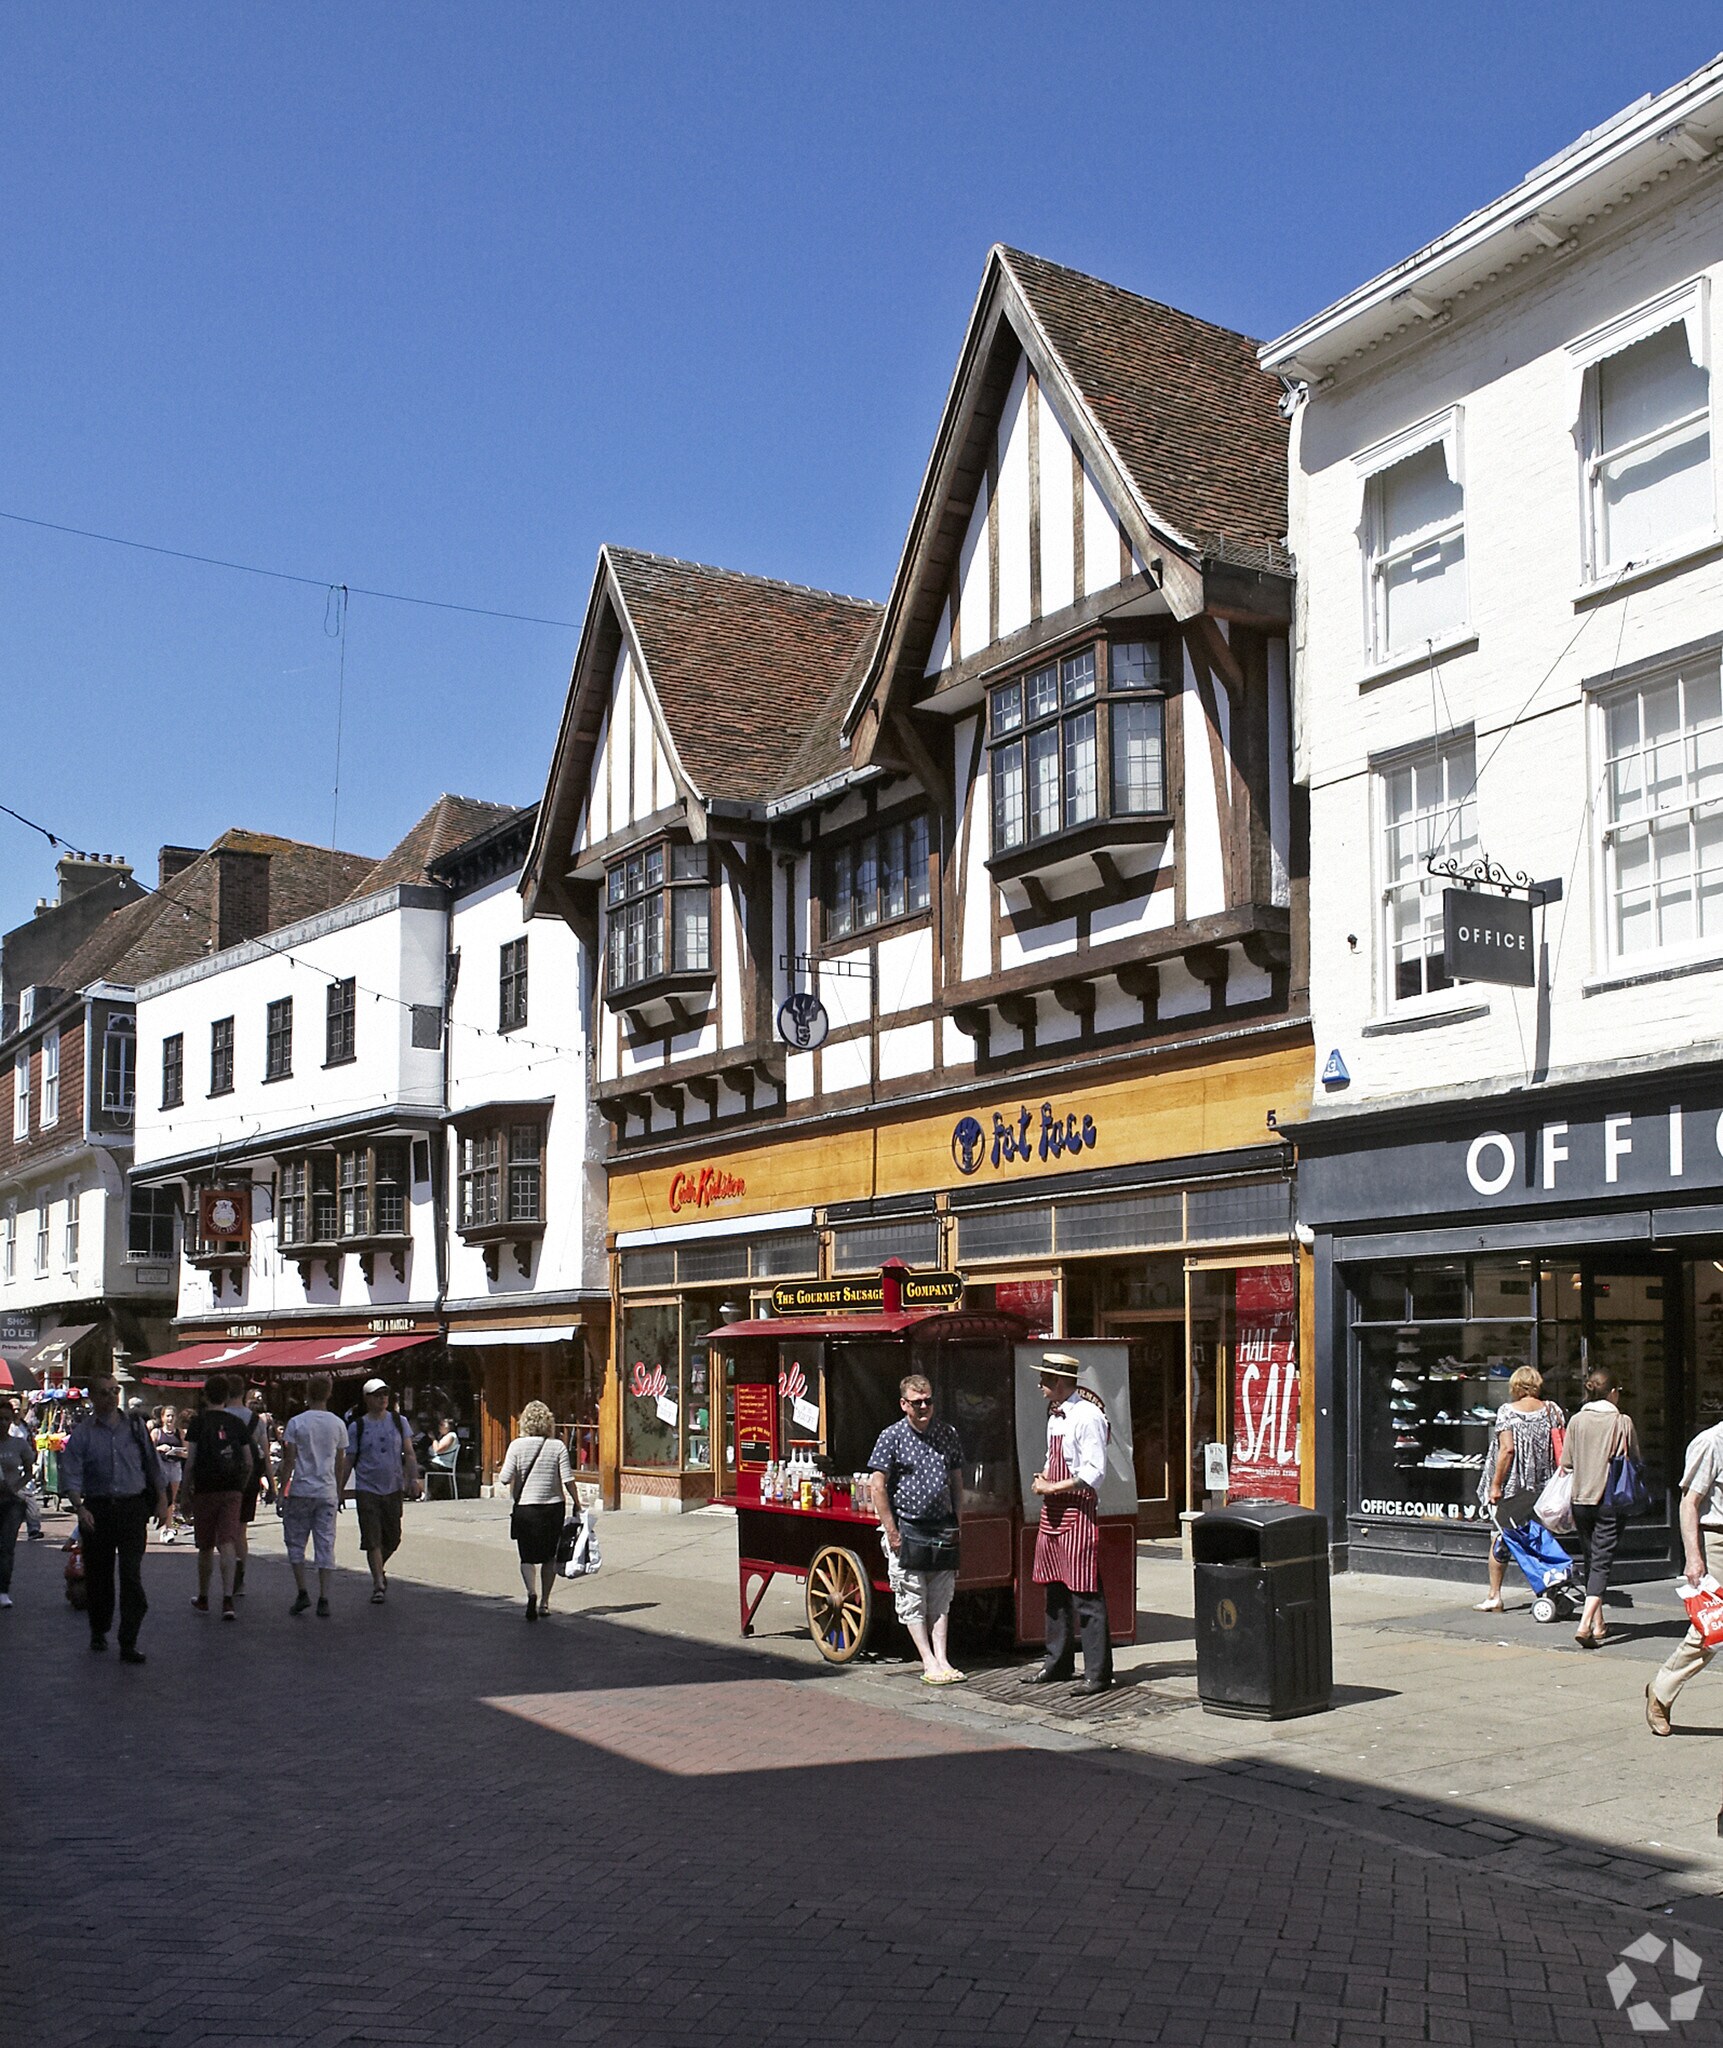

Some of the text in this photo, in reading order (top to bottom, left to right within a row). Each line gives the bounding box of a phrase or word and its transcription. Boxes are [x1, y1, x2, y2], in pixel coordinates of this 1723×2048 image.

[1458, 926, 1526, 950] OFFICE
[1266, 1110, 1277, 1127] 5
[1466, 1104, 1723, 1196] OFFI
[776, 1282, 954, 1305] THE GOURMET SAUSAGE COMPANY
[2, 1329, 35, 1337] TO LET
[7, 1317, 31, 1325] SHOP
[1240, 1328, 1278, 1362] HALF
[630, 1362, 669, 1397] Sale
[778, 1362, 808, 1398] ale
[1236, 1363, 1301, 1466] SAL
[1361, 1499, 1444, 1518] OFFICE.CO.UK
